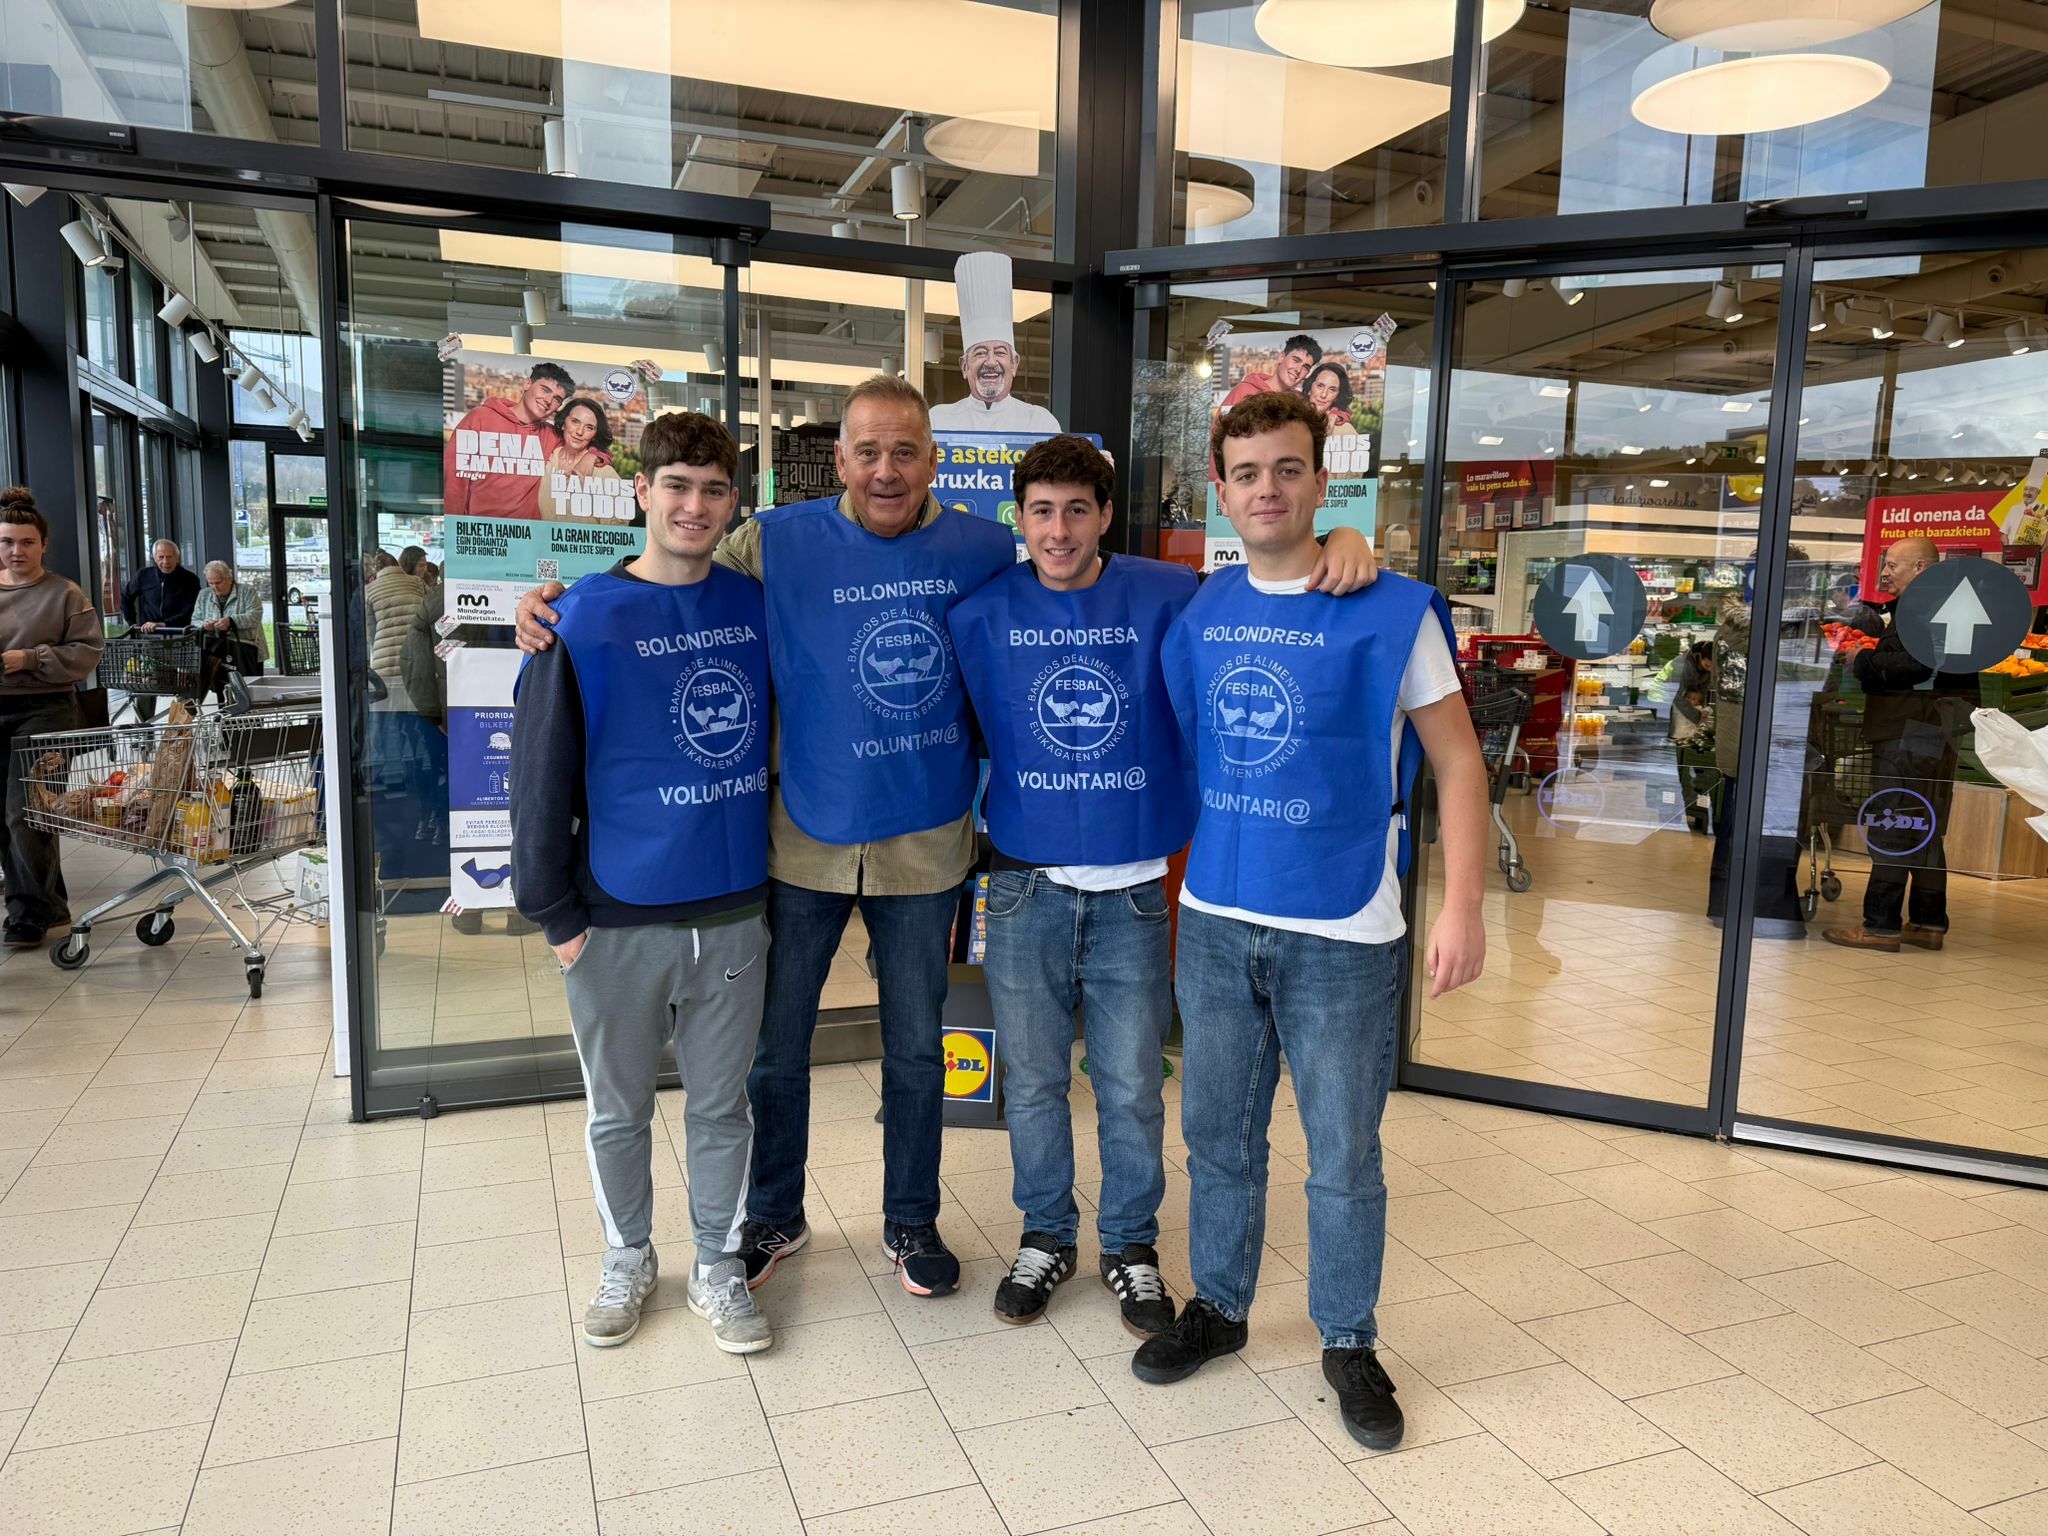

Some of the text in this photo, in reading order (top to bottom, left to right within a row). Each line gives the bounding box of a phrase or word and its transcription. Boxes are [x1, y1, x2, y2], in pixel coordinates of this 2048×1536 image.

[456, 429, 544, 460] DENA
[1323, 434, 1370, 451] MOS
[456, 454, 545, 477] EMATEN
[951, 445, 1026, 465] asteko
[1323, 451, 1370, 474] DO
[456, 471, 486, 481] dugu
[551, 473, 636, 498] DAMOS
[790, 463, 824, 490] agur
[1466, 471, 1510, 482] Lo maravilloso
[1466, 484, 1479, 492] vale
[1479, 483, 1486, 491] la
[1486, 482, 1501, 492] pena
[1502, 479, 1518, 489] cada
[1328, 485, 1367, 498] RECOGIDA
[235, 511, 244, 520] P
[551, 491, 636, 520] TODO
[1882, 505, 1985, 524] Lidl onena da
[456, 521, 532, 540] BILKETA HANDIA
[551, 527, 635, 546] LA GRAN RECOGIDA
[1880, 526, 1991, 539] fruta eta barazkietan
[456, 536, 509, 548] EGIN DOHAINTZA
[456, 546, 507, 557] SUPER HONETAN
[551, 543, 615, 556] DONA EN ESTE SUPER
[833, 579, 958, 604] BOLONDRESA
[635, 625, 758, 657] BOLONDRESA
[848, 607, 953, 663] BANCOS DE ALIMENTOS
[876, 632, 931, 649] FESBAL
[1009, 626, 1139, 646] BOLONDRESA
[1203, 625, 1325, 647] BOLONDRESA
[669, 656, 756, 714] BANCOS DE ALIMENTOS
[1028, 653, 1129, 702] BANCOS DE ALIMENTOS
[1055, 679, 1104, 691] FESBAL
[1235, 653, 1251, 666] DE
[1253, 654, 1306, 714] ALIMENTOS
[692, 680, 735, 697] FESBAL
[852, 672, 953, 721] ELIKAGAIEN BANKUA
[1225, 682, 1277, 698] FESBAL
[479, 721, 513, 729] BILKETA
[673, 720, 758, 770] ELIKAGAEN BANKUA
[852, 722, 960, 759] VOLUNTARI@
[1029, 719, 1129, 762] ELIKAGAIEN BANKUA
[1255, 736, 1302, 778] BANKUA
[658, 766, 769, 806] VOLUNTARI@
[1017, 766, 1147, 791] VOLUNTARI@
